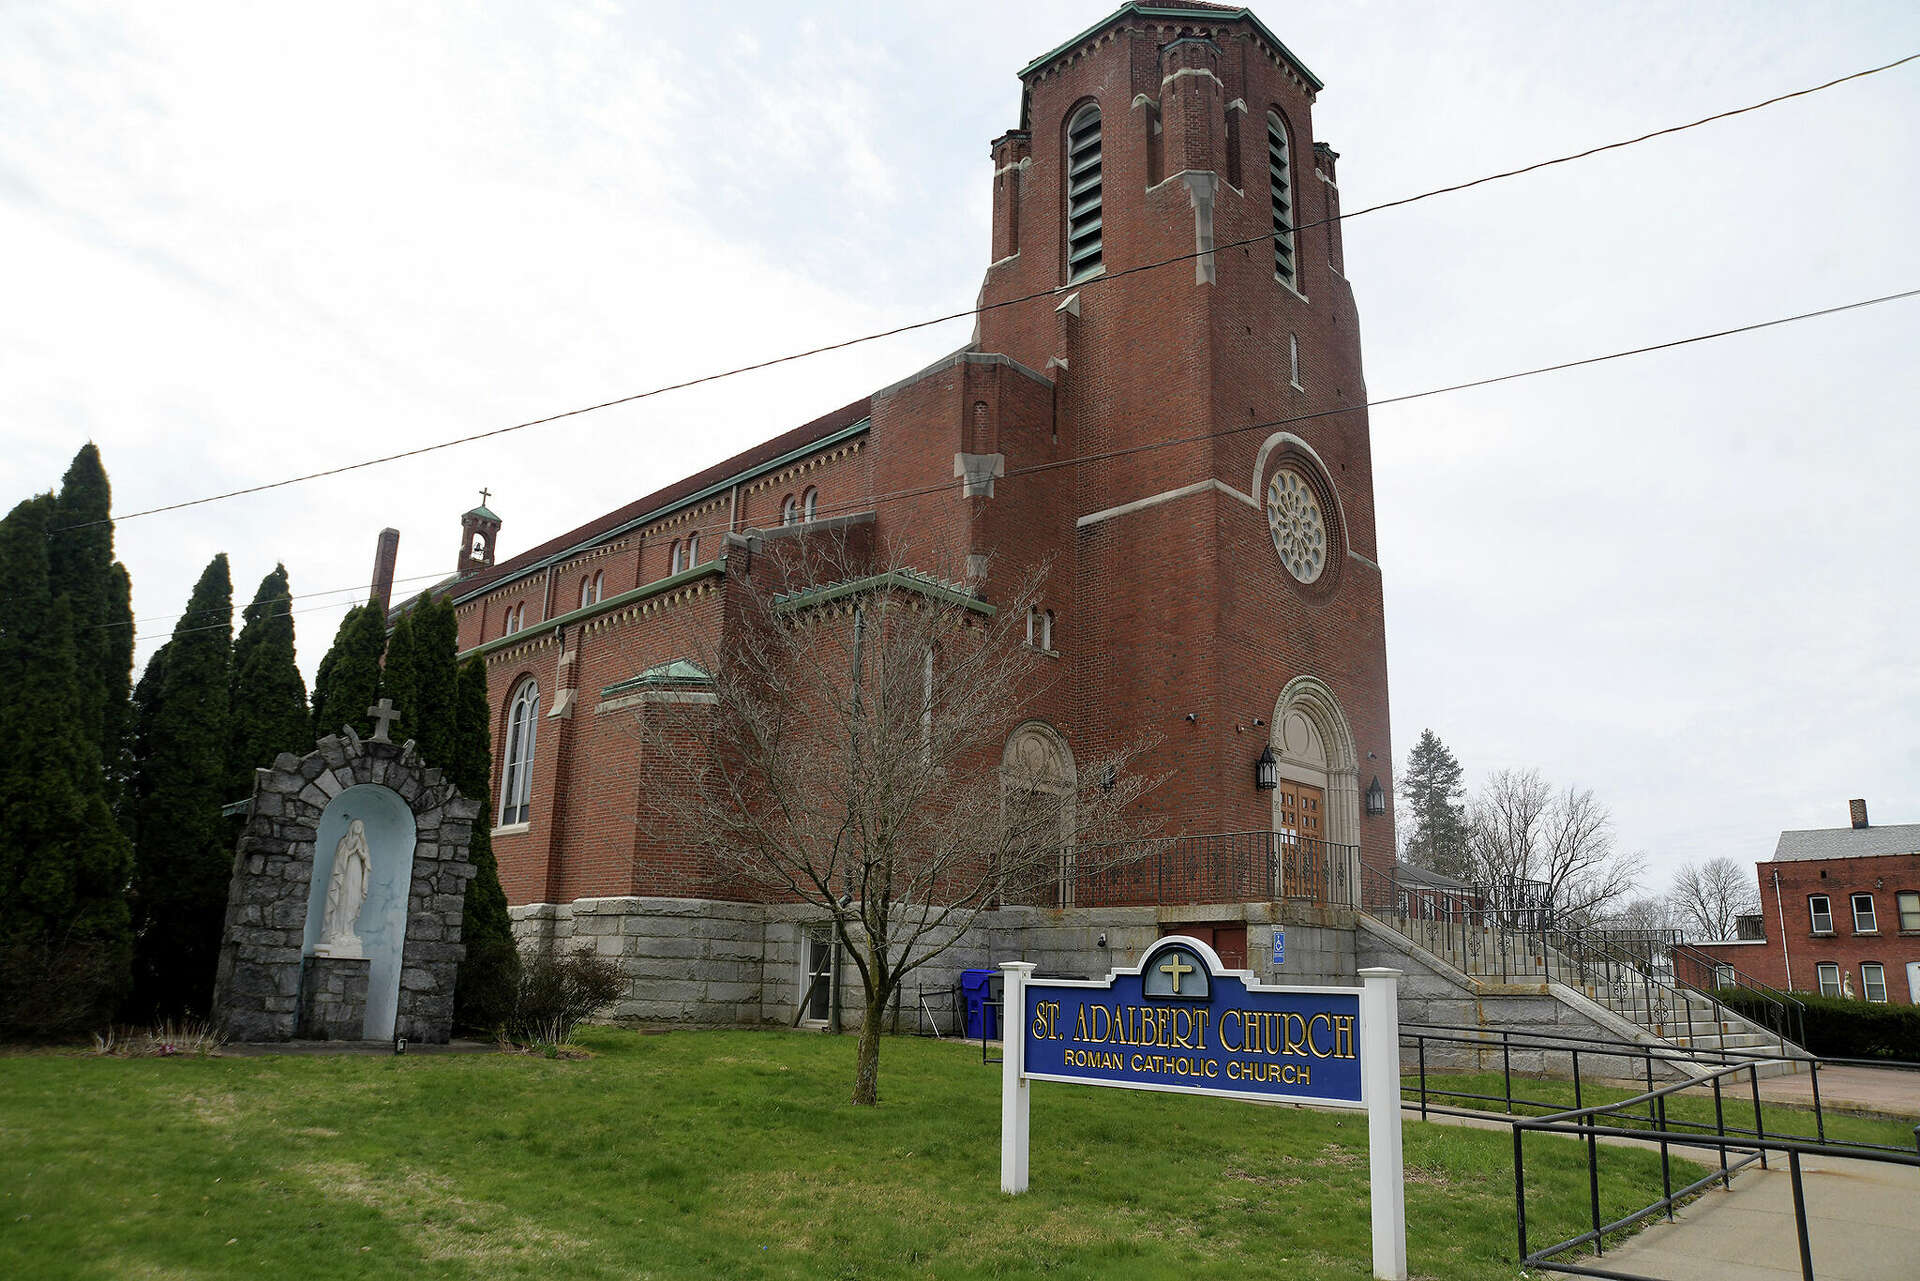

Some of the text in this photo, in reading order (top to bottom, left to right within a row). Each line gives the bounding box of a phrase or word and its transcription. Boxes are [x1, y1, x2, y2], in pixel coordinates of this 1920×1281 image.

[1032, 1001, 1356, 1059] ST. ADALBERT CHURCH
[1065, 1050, 1311, 1085] ROMAN CATHOLIC CHURCH
